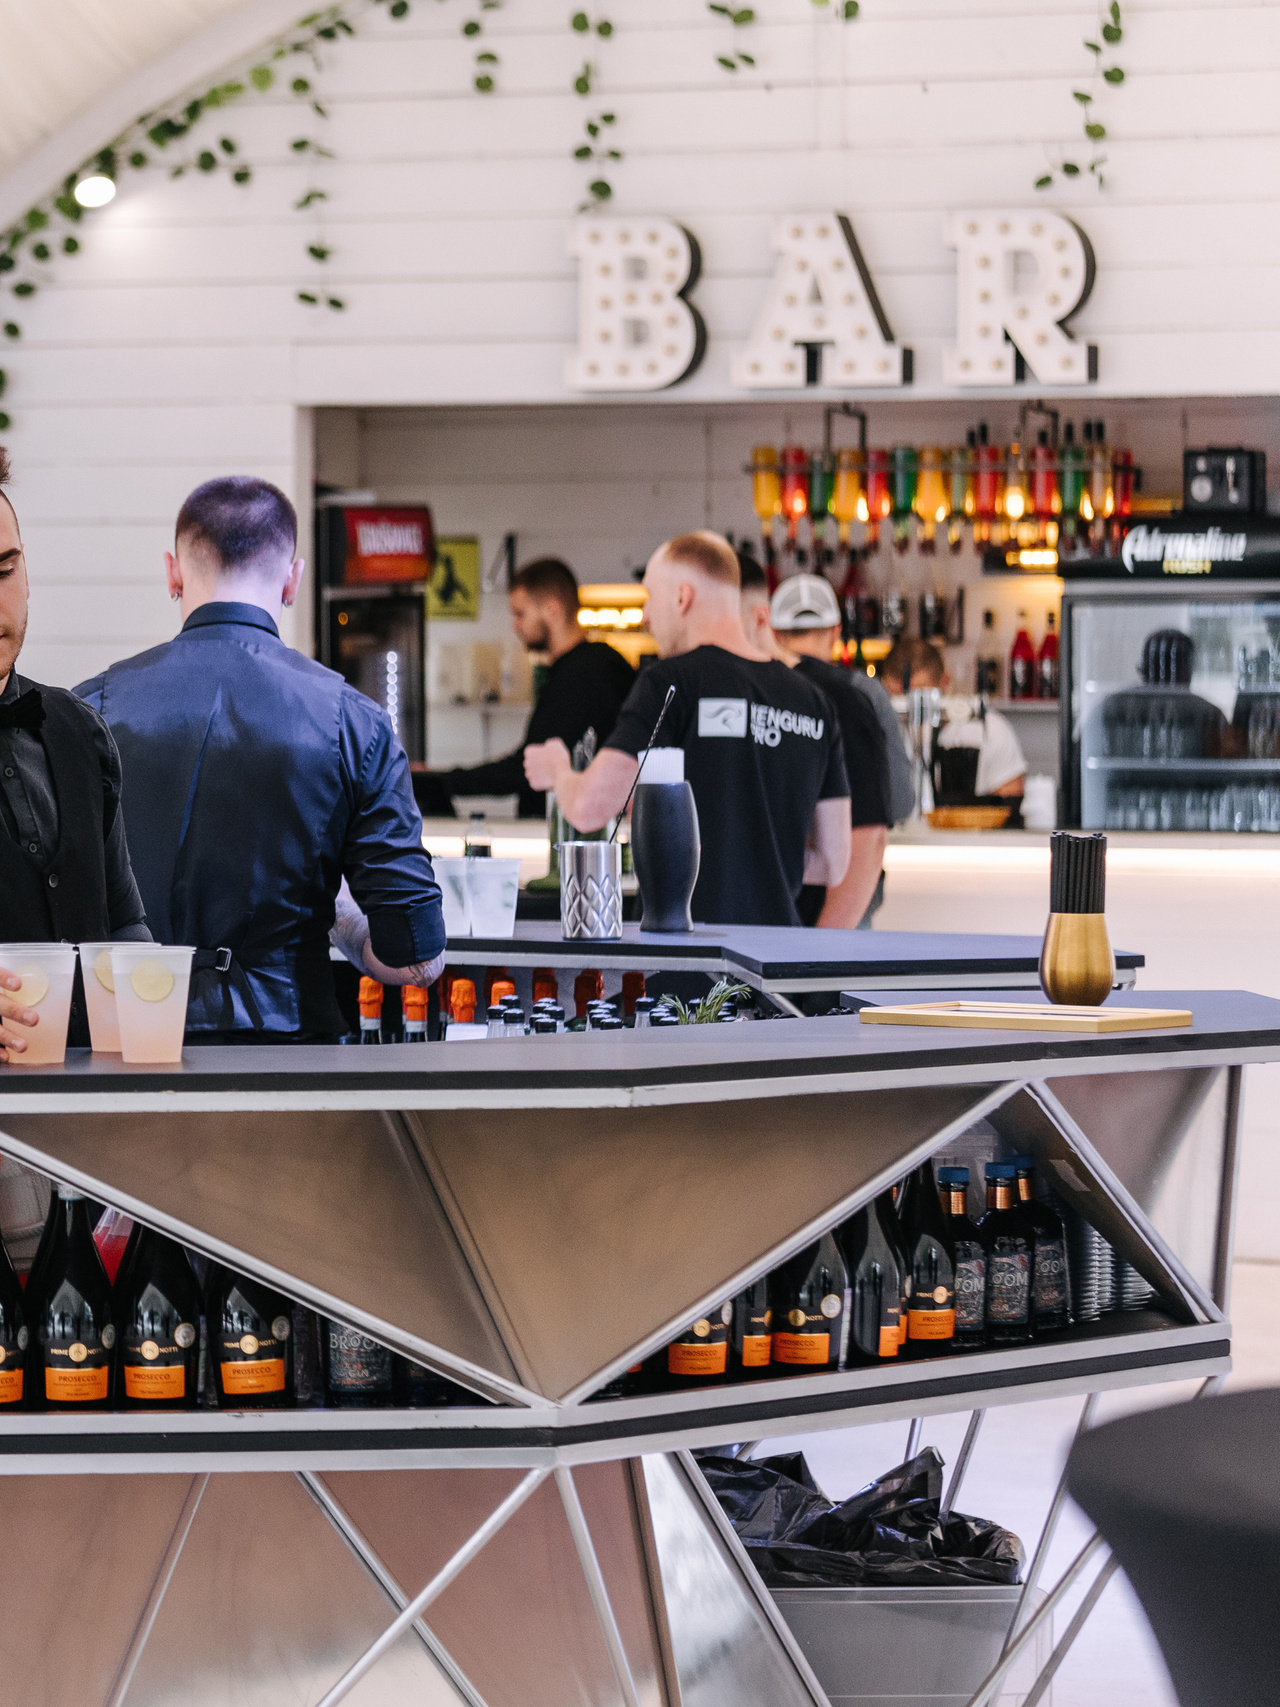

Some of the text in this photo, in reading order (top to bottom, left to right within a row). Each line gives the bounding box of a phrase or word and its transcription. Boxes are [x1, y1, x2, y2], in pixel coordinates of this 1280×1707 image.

[565, 206, 1098, 390] BAR
[1122, 524, 1247, 574] Adrenaline
[1162, 559, 1212, 575] RUSH
[750, 701, 824, 740] KENGURU
[750, 722, 781, 747] PRO
[159, 1346, 179, 1354] NOTTI
[133, 1372, 171, 1380] PROSECCO
[232, 1366, 272, 1375] PROSECCO
